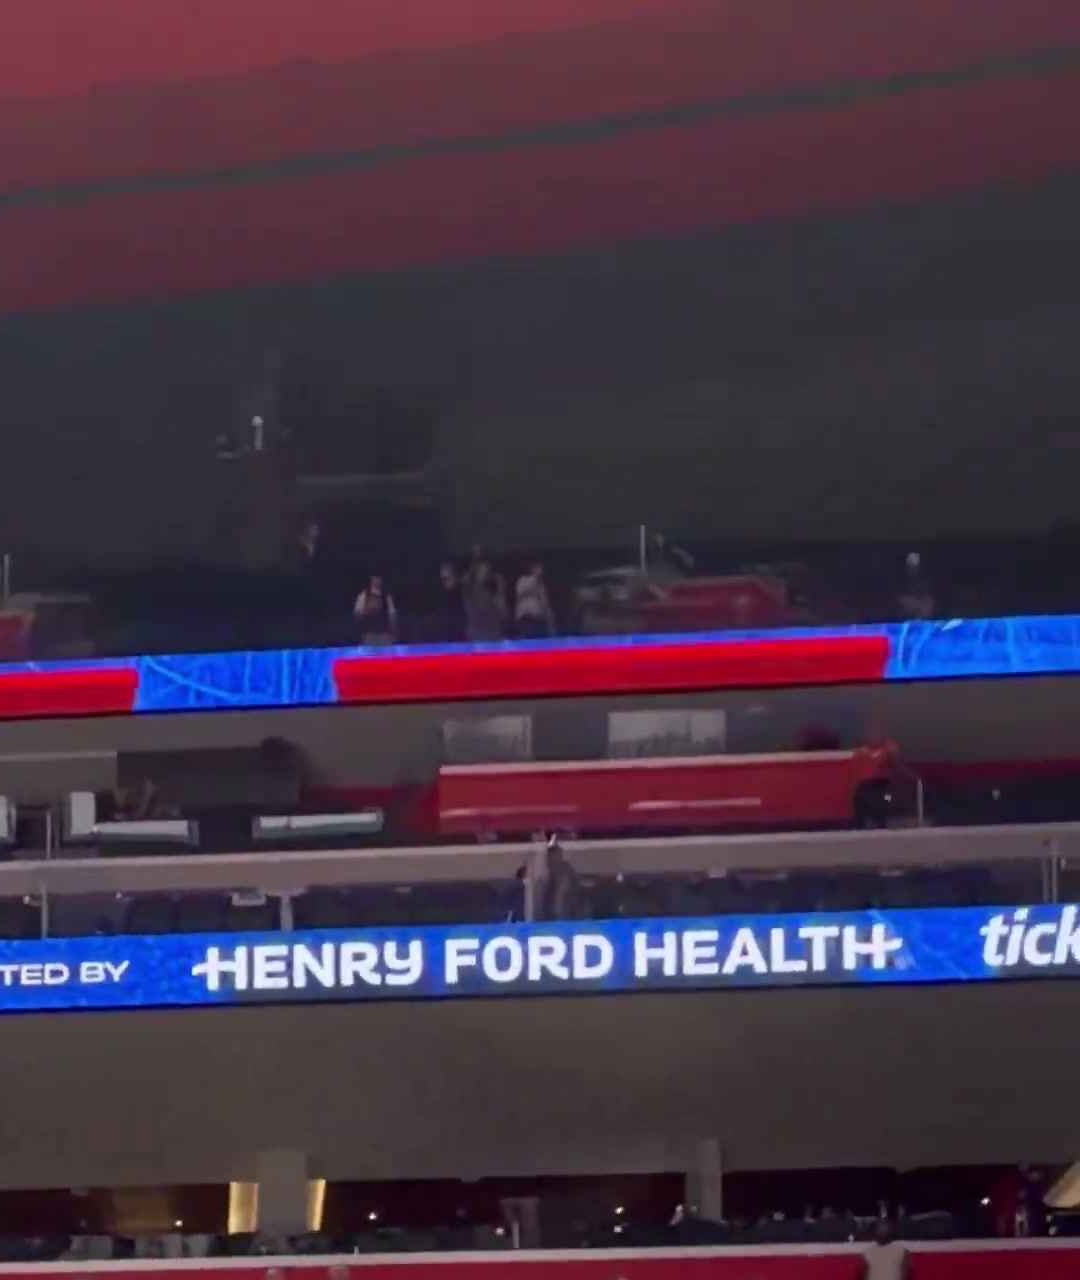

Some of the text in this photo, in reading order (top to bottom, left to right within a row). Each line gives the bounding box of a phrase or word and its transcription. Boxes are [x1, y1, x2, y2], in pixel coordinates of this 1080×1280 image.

[80, 960, 129, 984] BY
[192, 923, 903, 991] HENRY FORD HEALTH
